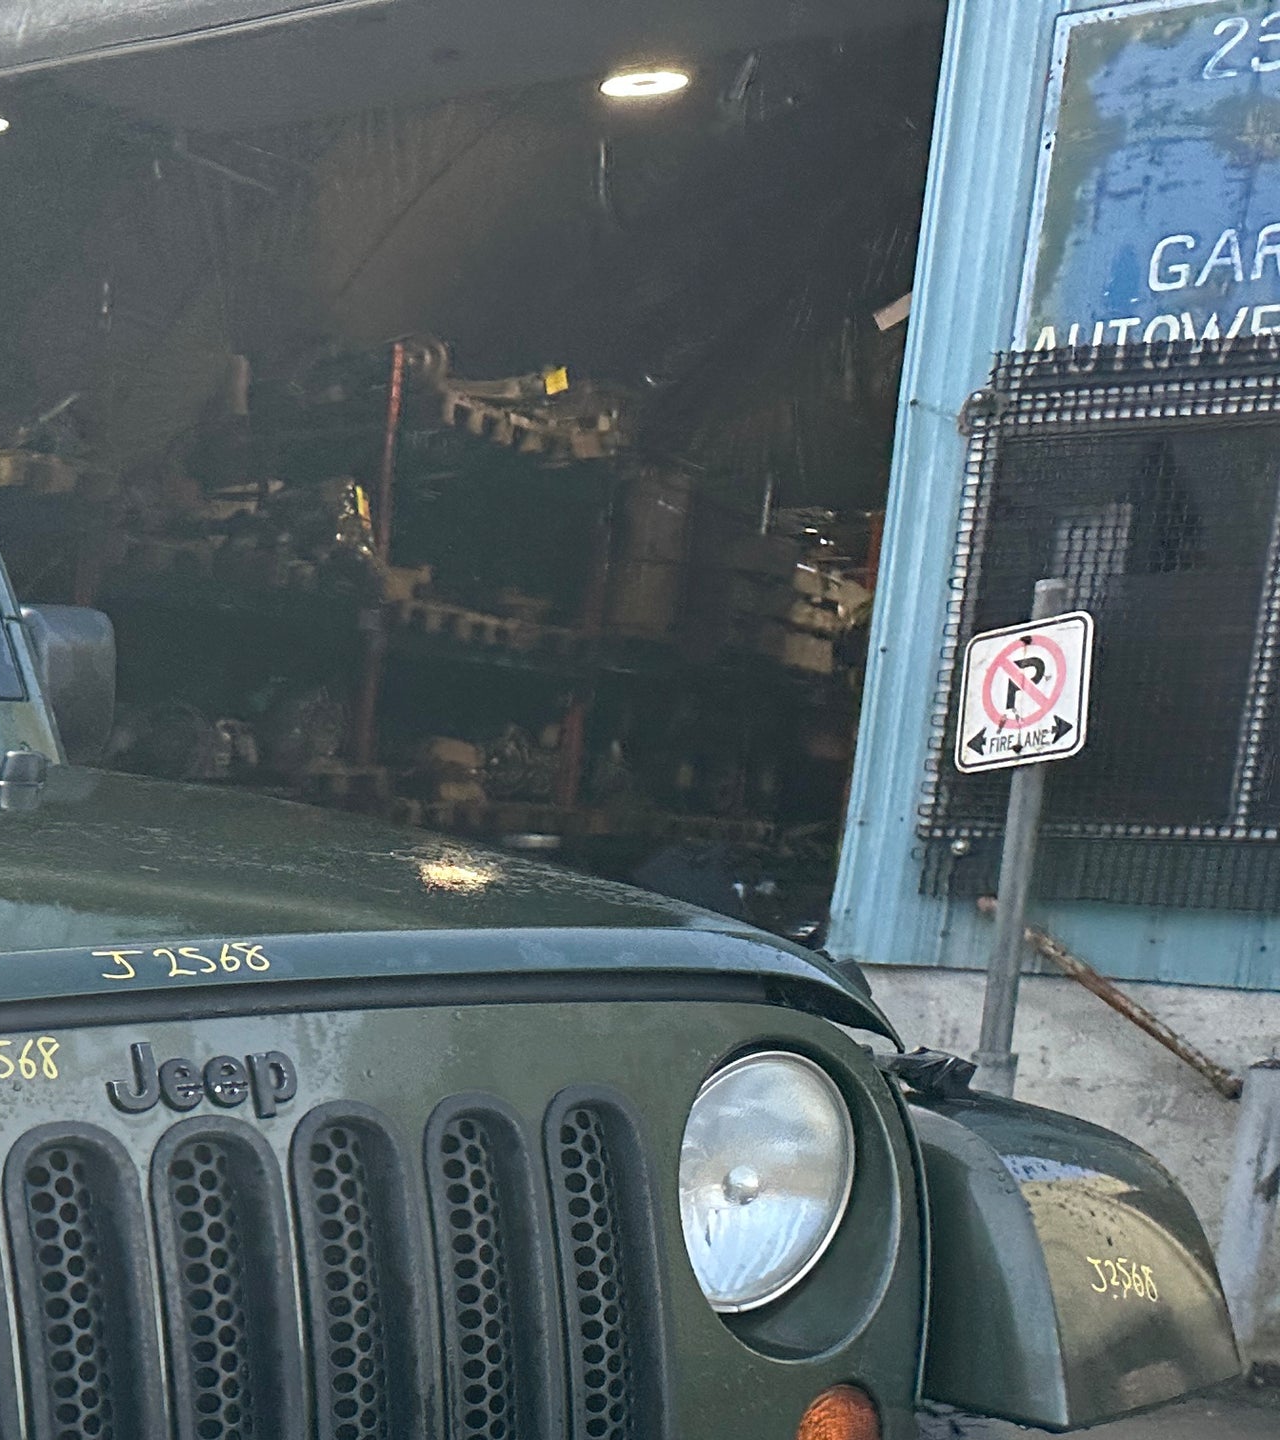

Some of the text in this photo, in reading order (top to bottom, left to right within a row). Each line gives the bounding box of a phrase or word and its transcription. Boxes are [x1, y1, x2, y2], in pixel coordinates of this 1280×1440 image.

[989, 734, 1015, 754] FIRE
[106, 1041, 298, 1119] Jeep
[1086, 1256, 1159, 1302] J2568
